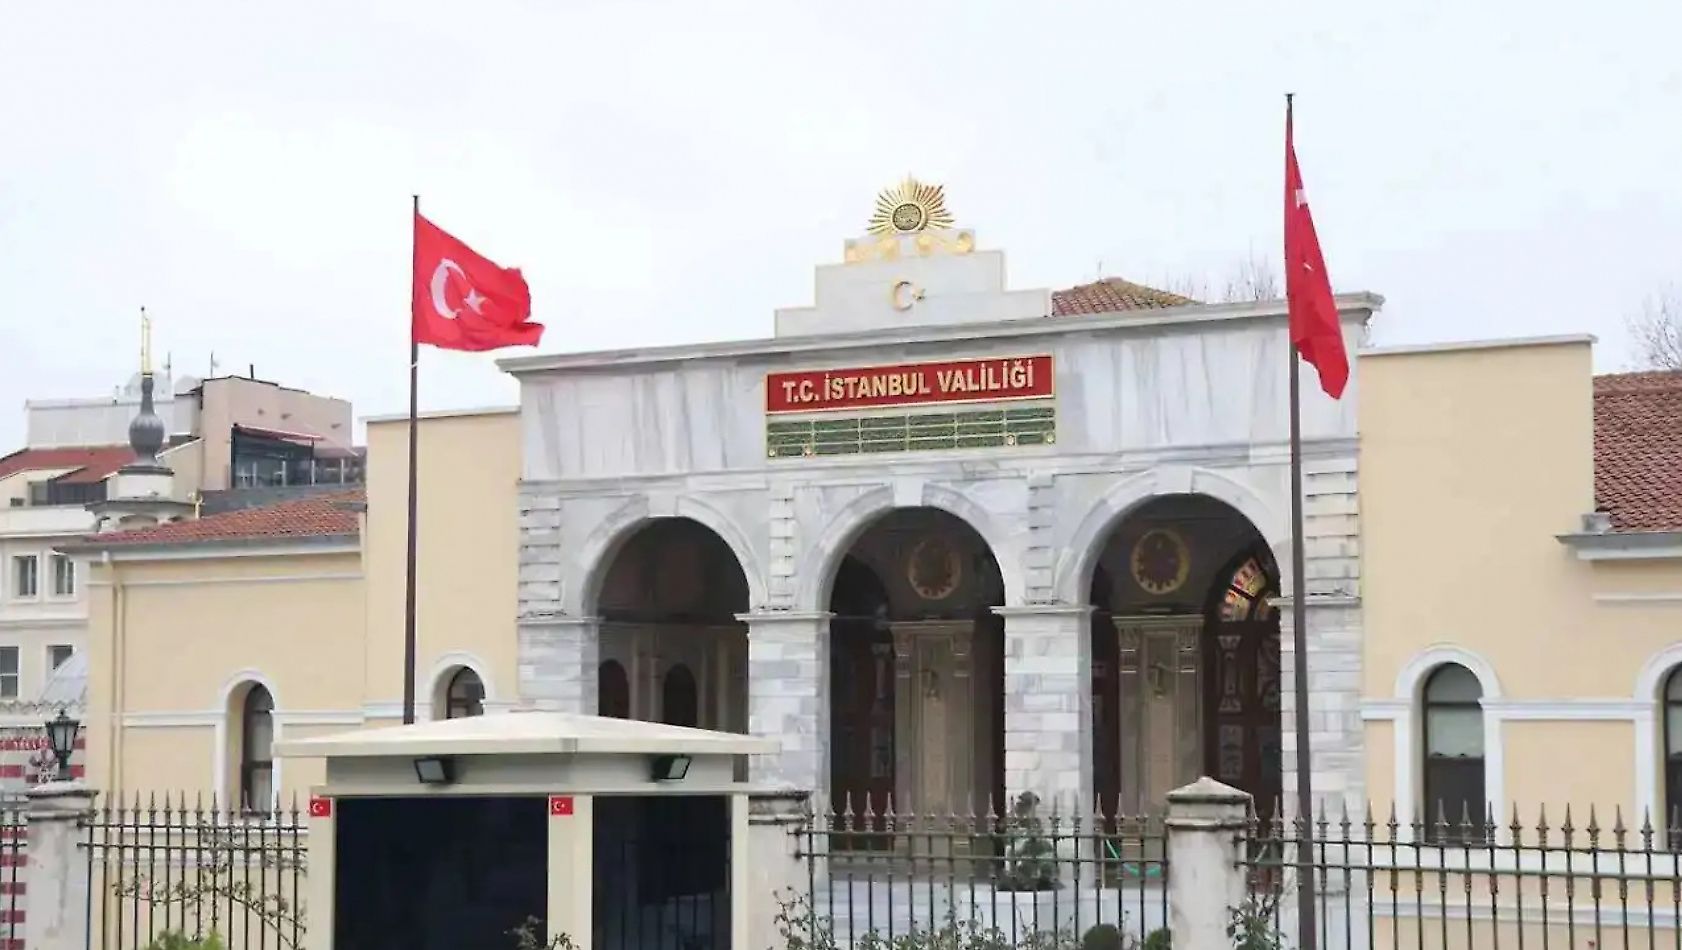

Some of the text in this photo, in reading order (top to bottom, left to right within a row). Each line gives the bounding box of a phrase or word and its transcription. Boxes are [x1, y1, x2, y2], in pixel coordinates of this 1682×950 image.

[782, 360, 1034, 403] T.C. İSTANBUL VALİLİĞİ
